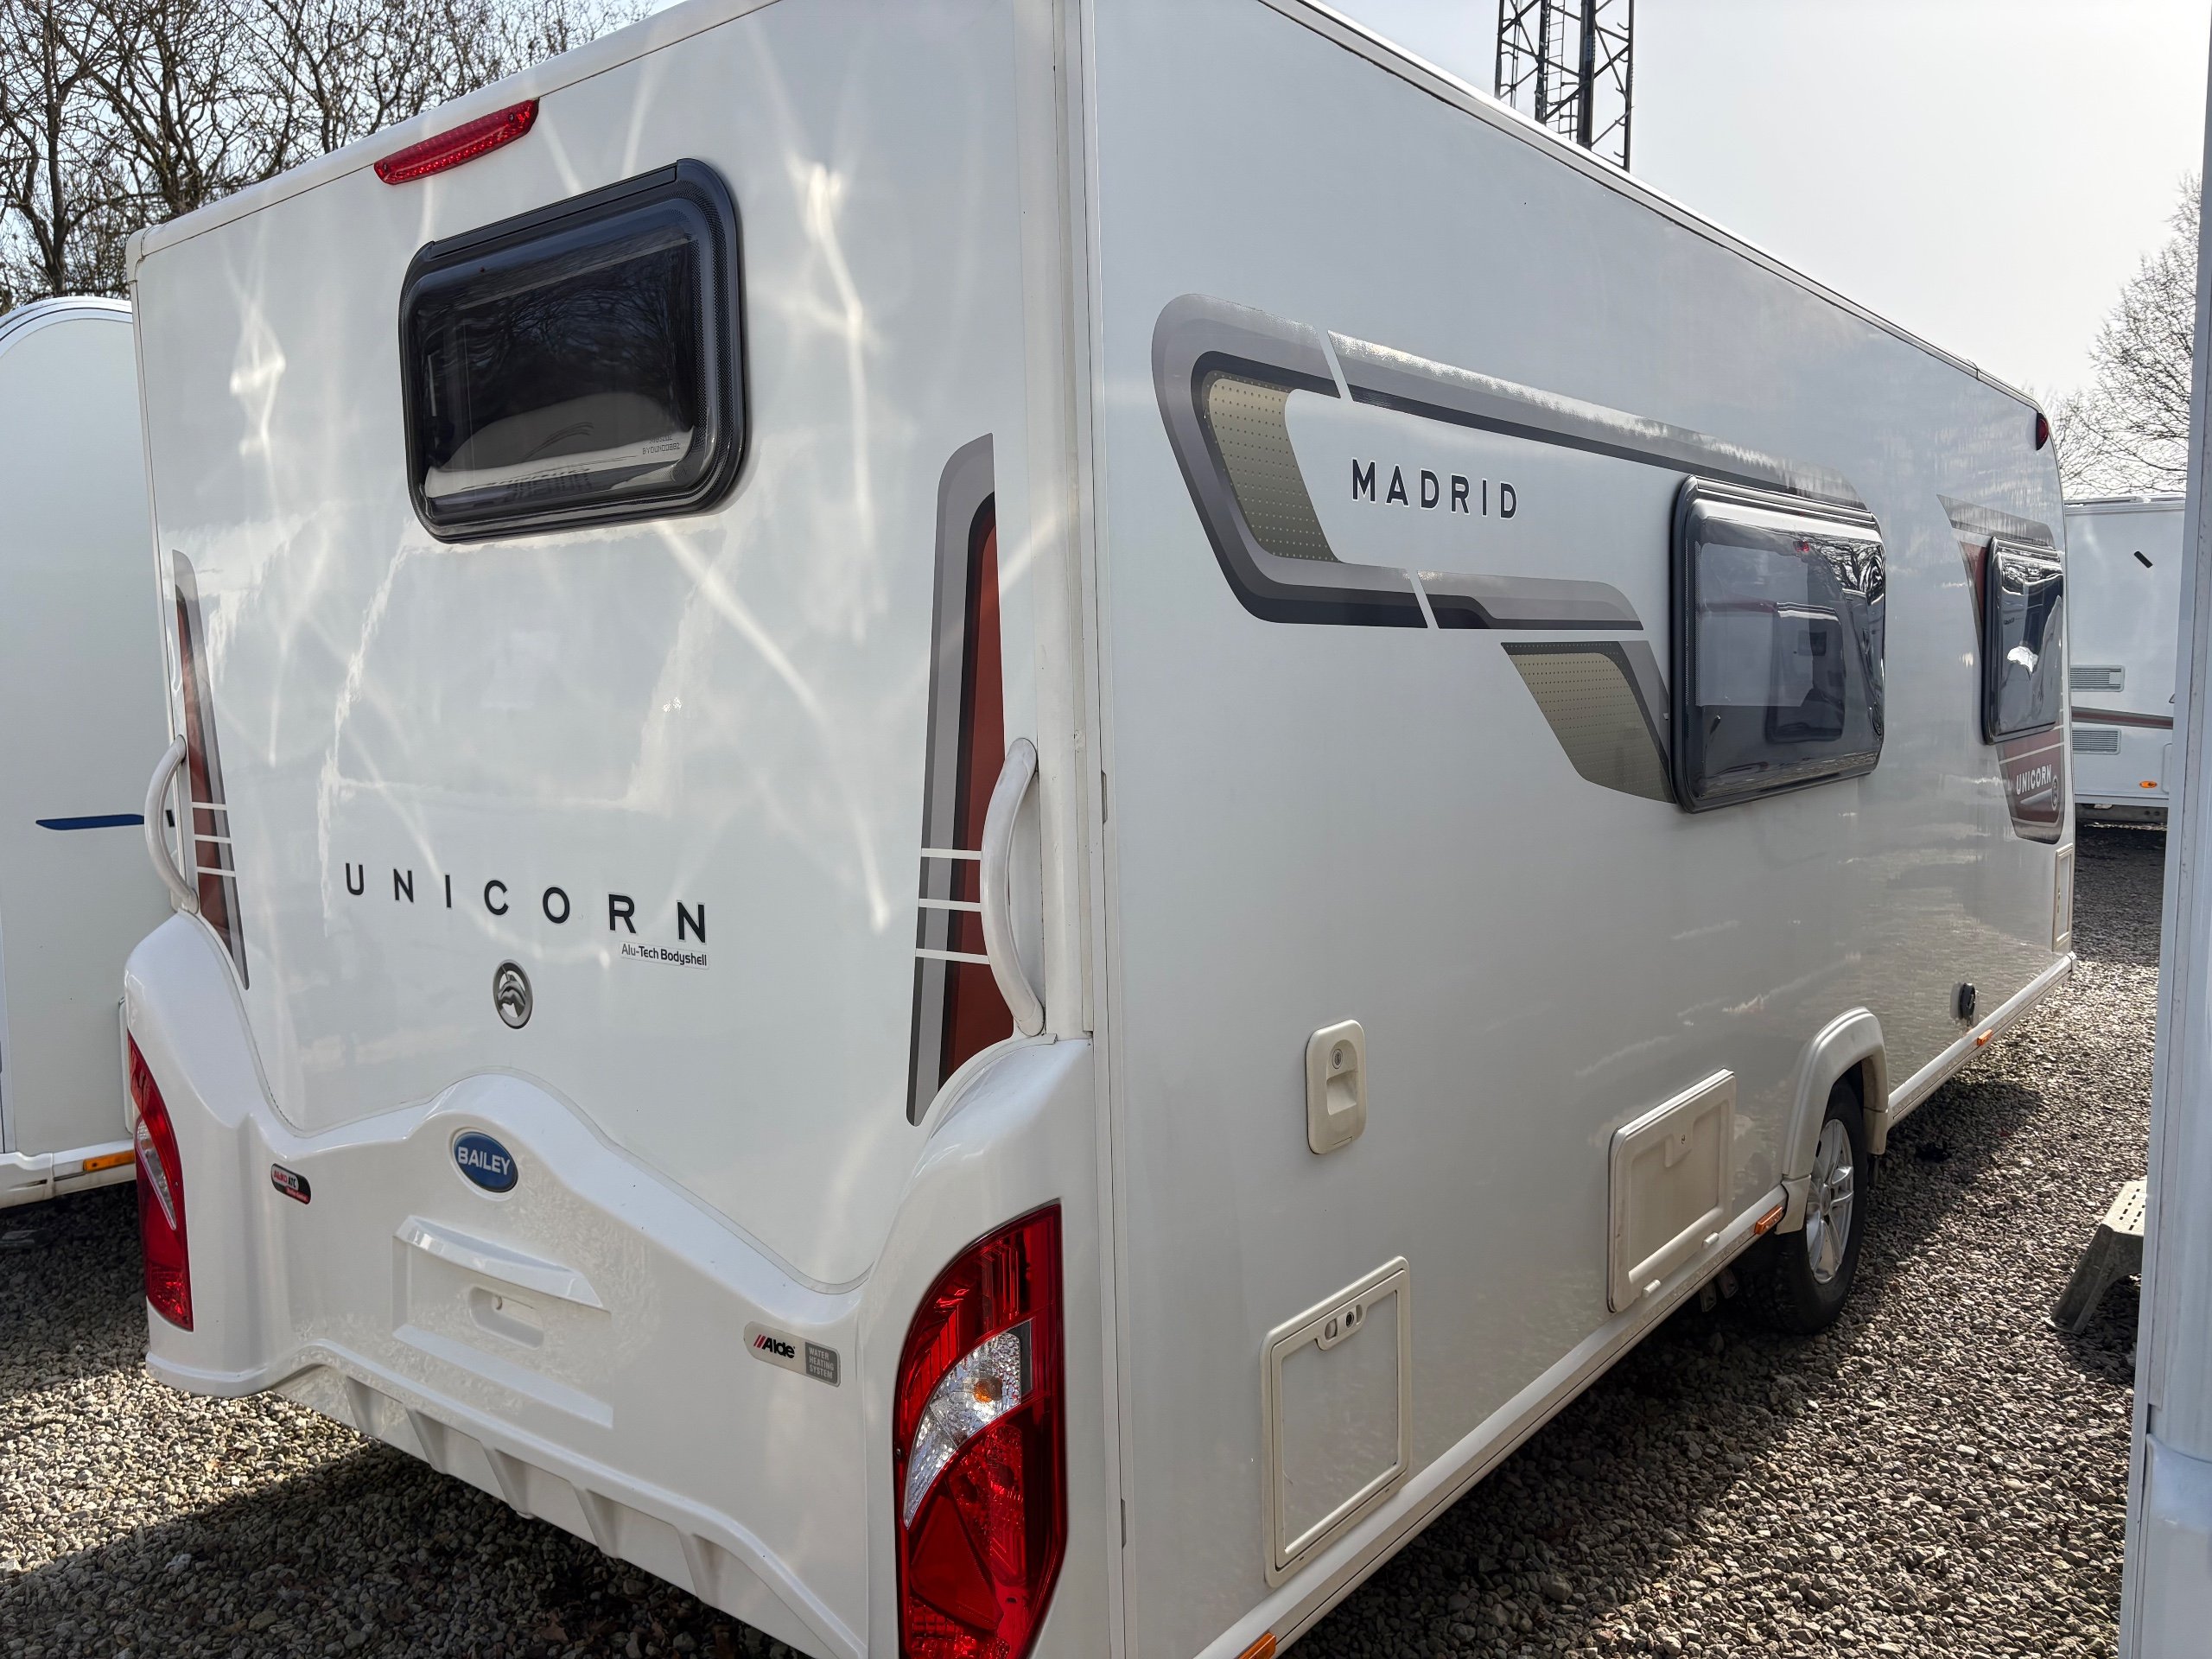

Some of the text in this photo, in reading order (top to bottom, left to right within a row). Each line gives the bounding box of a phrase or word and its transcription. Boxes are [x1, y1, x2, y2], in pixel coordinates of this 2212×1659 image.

[1351, 458, 1517, 518] MADRID
[2016, 764, 2051, 795] UNICORN
[345, 862, 707, 944] UNICORN
[621, 943, 707, 966] Alu-Tech Bodyshell
[458, 1146, 511, 1176] BAILEY
[761, 1337, 795, 1359] Alde
[809, 1346, 830, 1361] WATER
[809, 1355, 835, 1371] HEATING
[809, 1364, 833, 1379] SYSTEM
